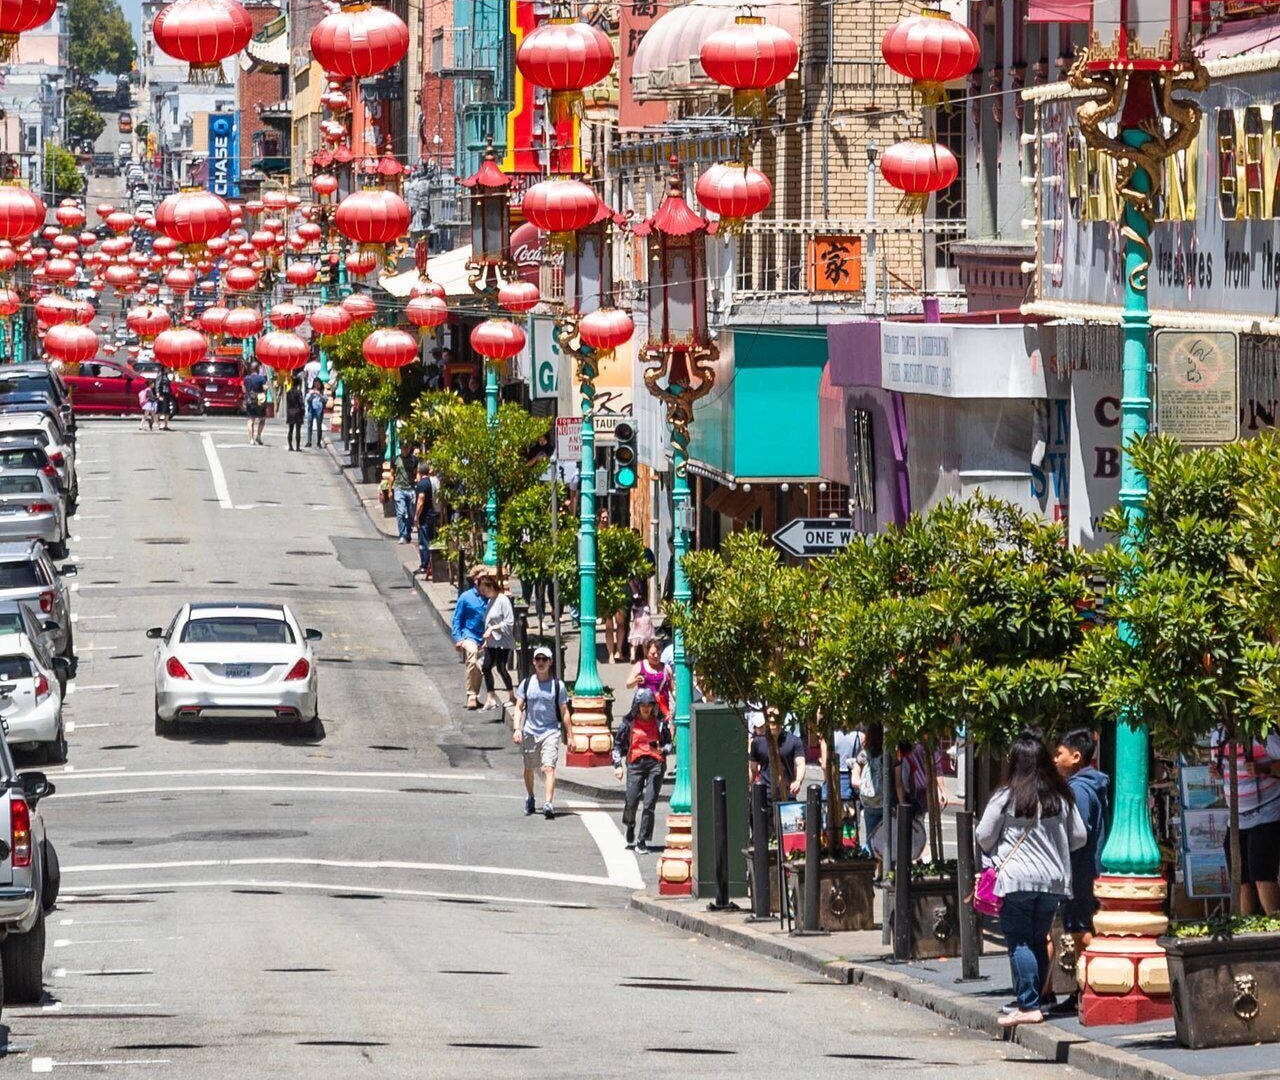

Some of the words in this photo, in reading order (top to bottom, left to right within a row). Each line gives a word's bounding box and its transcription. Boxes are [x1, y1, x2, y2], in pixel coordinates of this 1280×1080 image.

[214, 136, 228, 196] CHASE
[820, 242, 850, 285] 家
[1158, 244, 1213, 288] treasures
[1224, 241, 1251, 289] from
[1262, 239, 1280, 290] the
[805, 531, 834, 545] ONE
